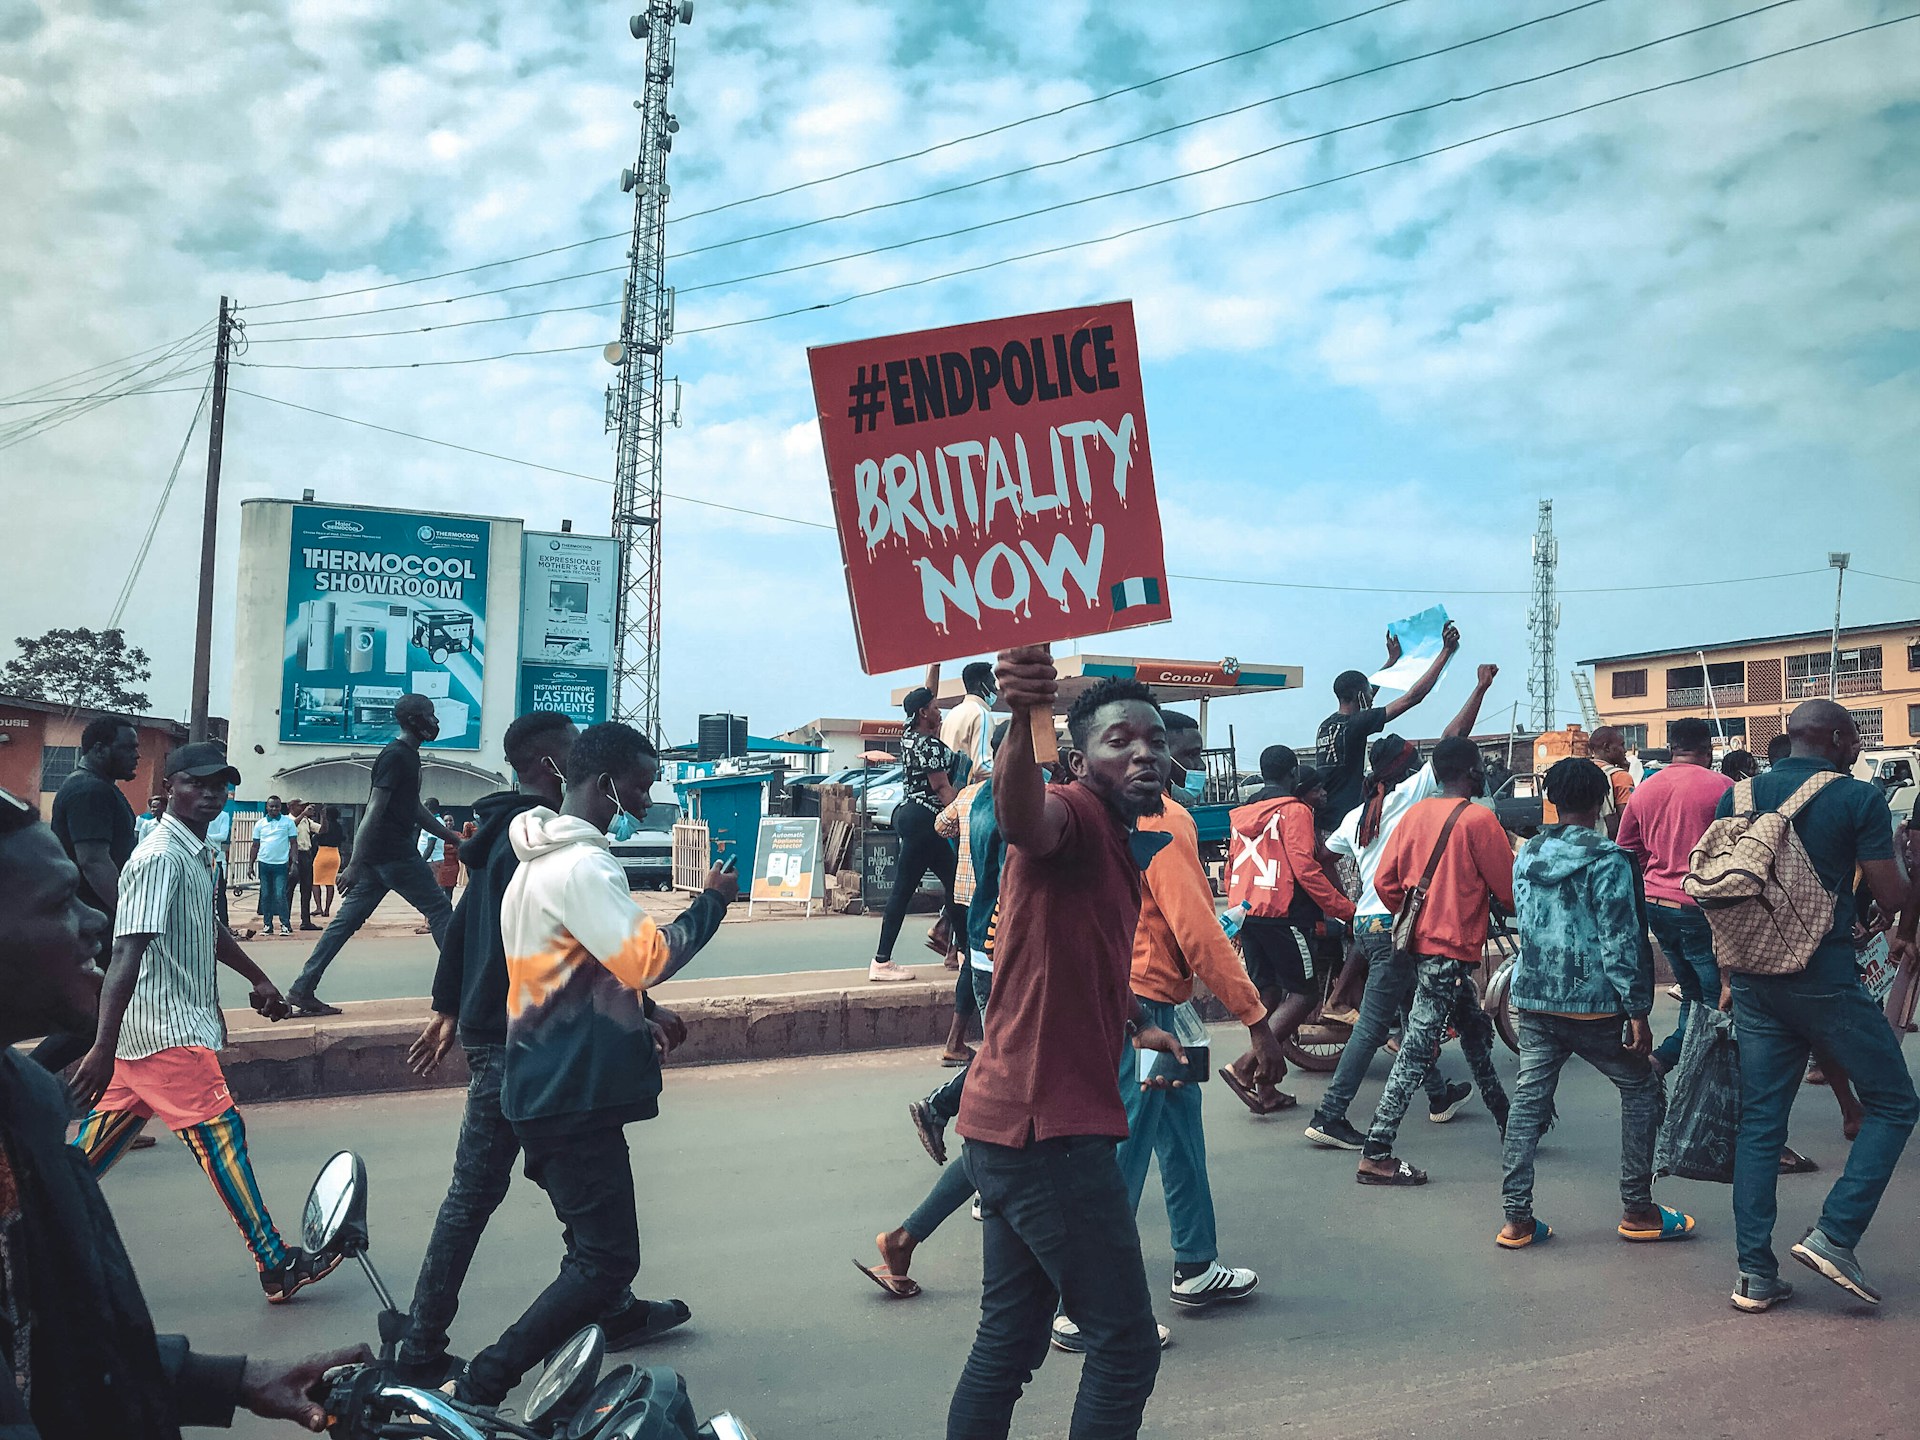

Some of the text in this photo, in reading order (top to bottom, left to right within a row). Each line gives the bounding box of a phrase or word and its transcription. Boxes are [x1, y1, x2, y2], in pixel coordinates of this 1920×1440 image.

[848, 325, 1120, 434] #ENDPOLICE
[855, 413, 1138, 560] BRUTALITY
[436, 531, 480, 539] THERMOCOOL
[303, 548, 476, 579] THERMOCOOL
[538, 561, 601, 572] MOTHER'S CARE
[539, 555, 588, 565] EXPRESSION
[315, 571, 462, 599] SHOWROOM
[912, 523, 1105, 634] NOW
[1159, 671, 1214, 684] Conoil
[533, 690, 595, 703] LASTING
[533, 702, 595, 713] MOMENTS
[873, 846, 886, 857] NO
[868, 856, 895, 866] PARKING
